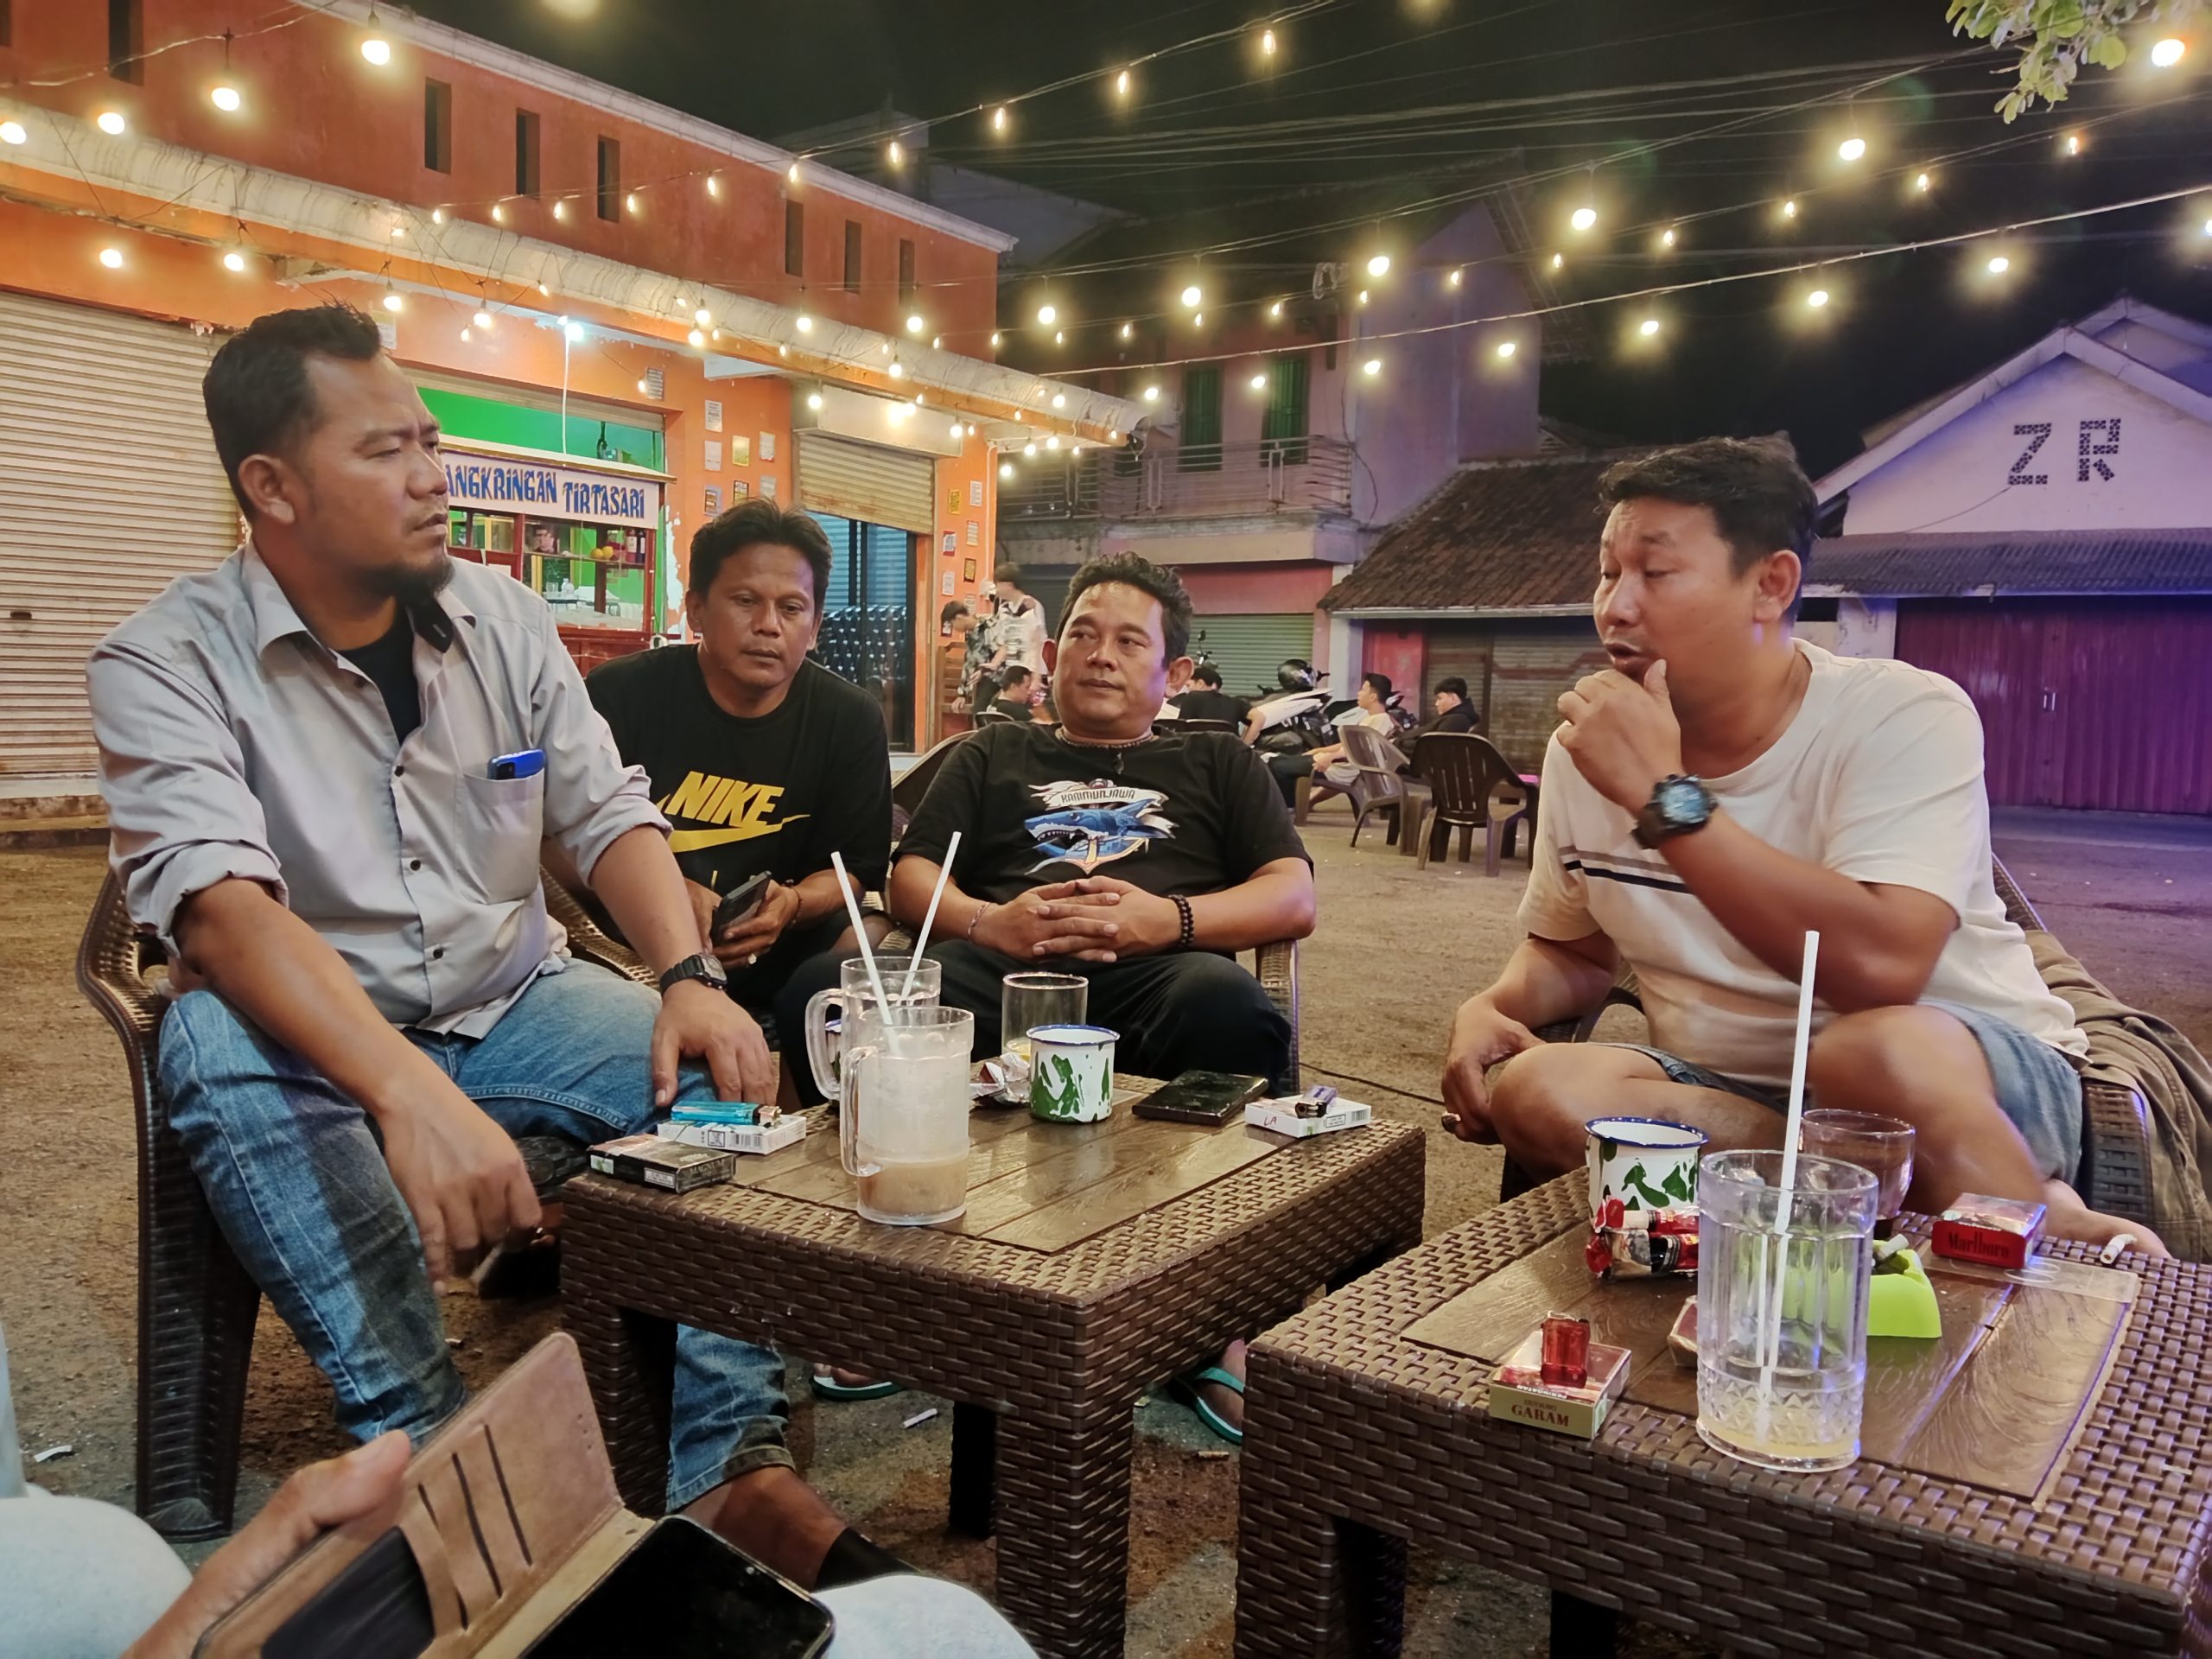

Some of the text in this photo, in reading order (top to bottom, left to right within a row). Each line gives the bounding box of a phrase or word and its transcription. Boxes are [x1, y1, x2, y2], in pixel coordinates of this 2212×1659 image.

[445, 464, 645, 518] ANGKRINGAN TIRTASARI
[664, 771, 785, 827] NIKE
[1948, 1231, 2009, 1258] Marlboro
[1511, 1404, 1569, 1427] GARAM
